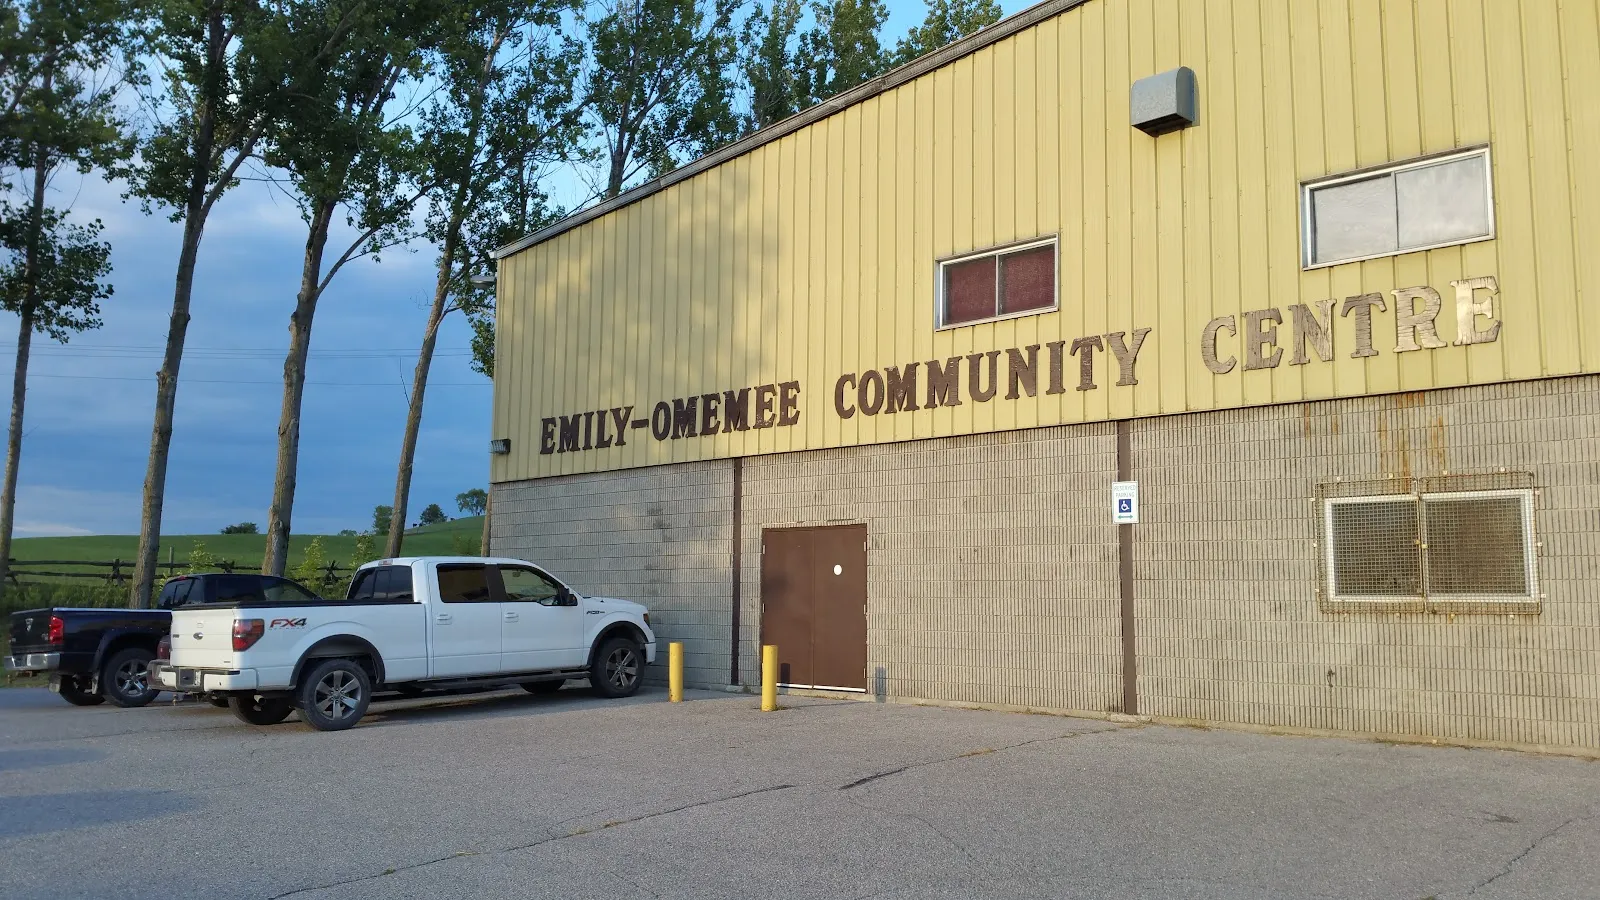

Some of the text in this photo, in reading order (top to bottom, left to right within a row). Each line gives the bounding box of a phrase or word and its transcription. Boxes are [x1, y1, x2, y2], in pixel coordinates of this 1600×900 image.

[539, 275, 1503, 455] EMILY-OMEMEE COMMUNITY CENTRE
[270, 617, 308, 628] FX4
